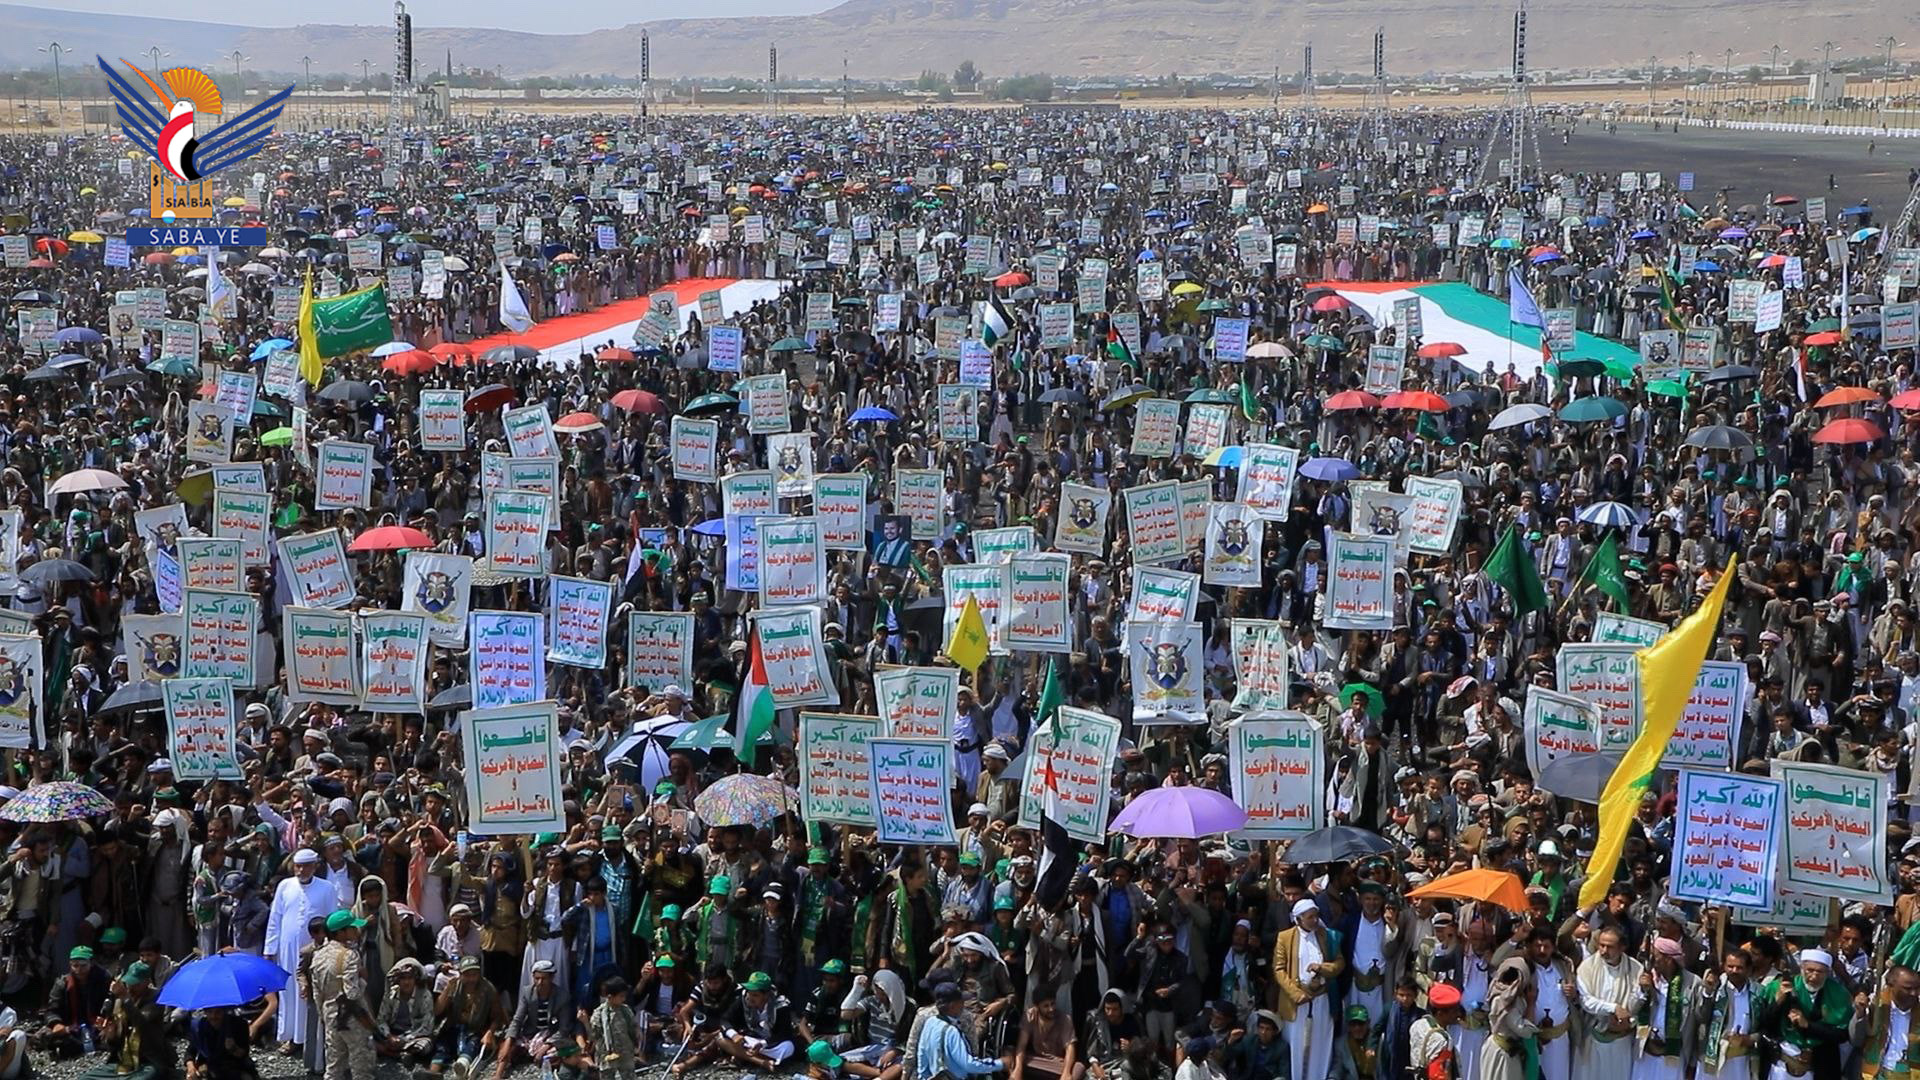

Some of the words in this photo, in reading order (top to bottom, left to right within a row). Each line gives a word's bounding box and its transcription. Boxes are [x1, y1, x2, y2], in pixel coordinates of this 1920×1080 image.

[478, 724, 547, 751] قاطعوا
[1244, 729, 1311, 754] قاطعوا
[1790, 779, 1871, 808] قاطعوا
